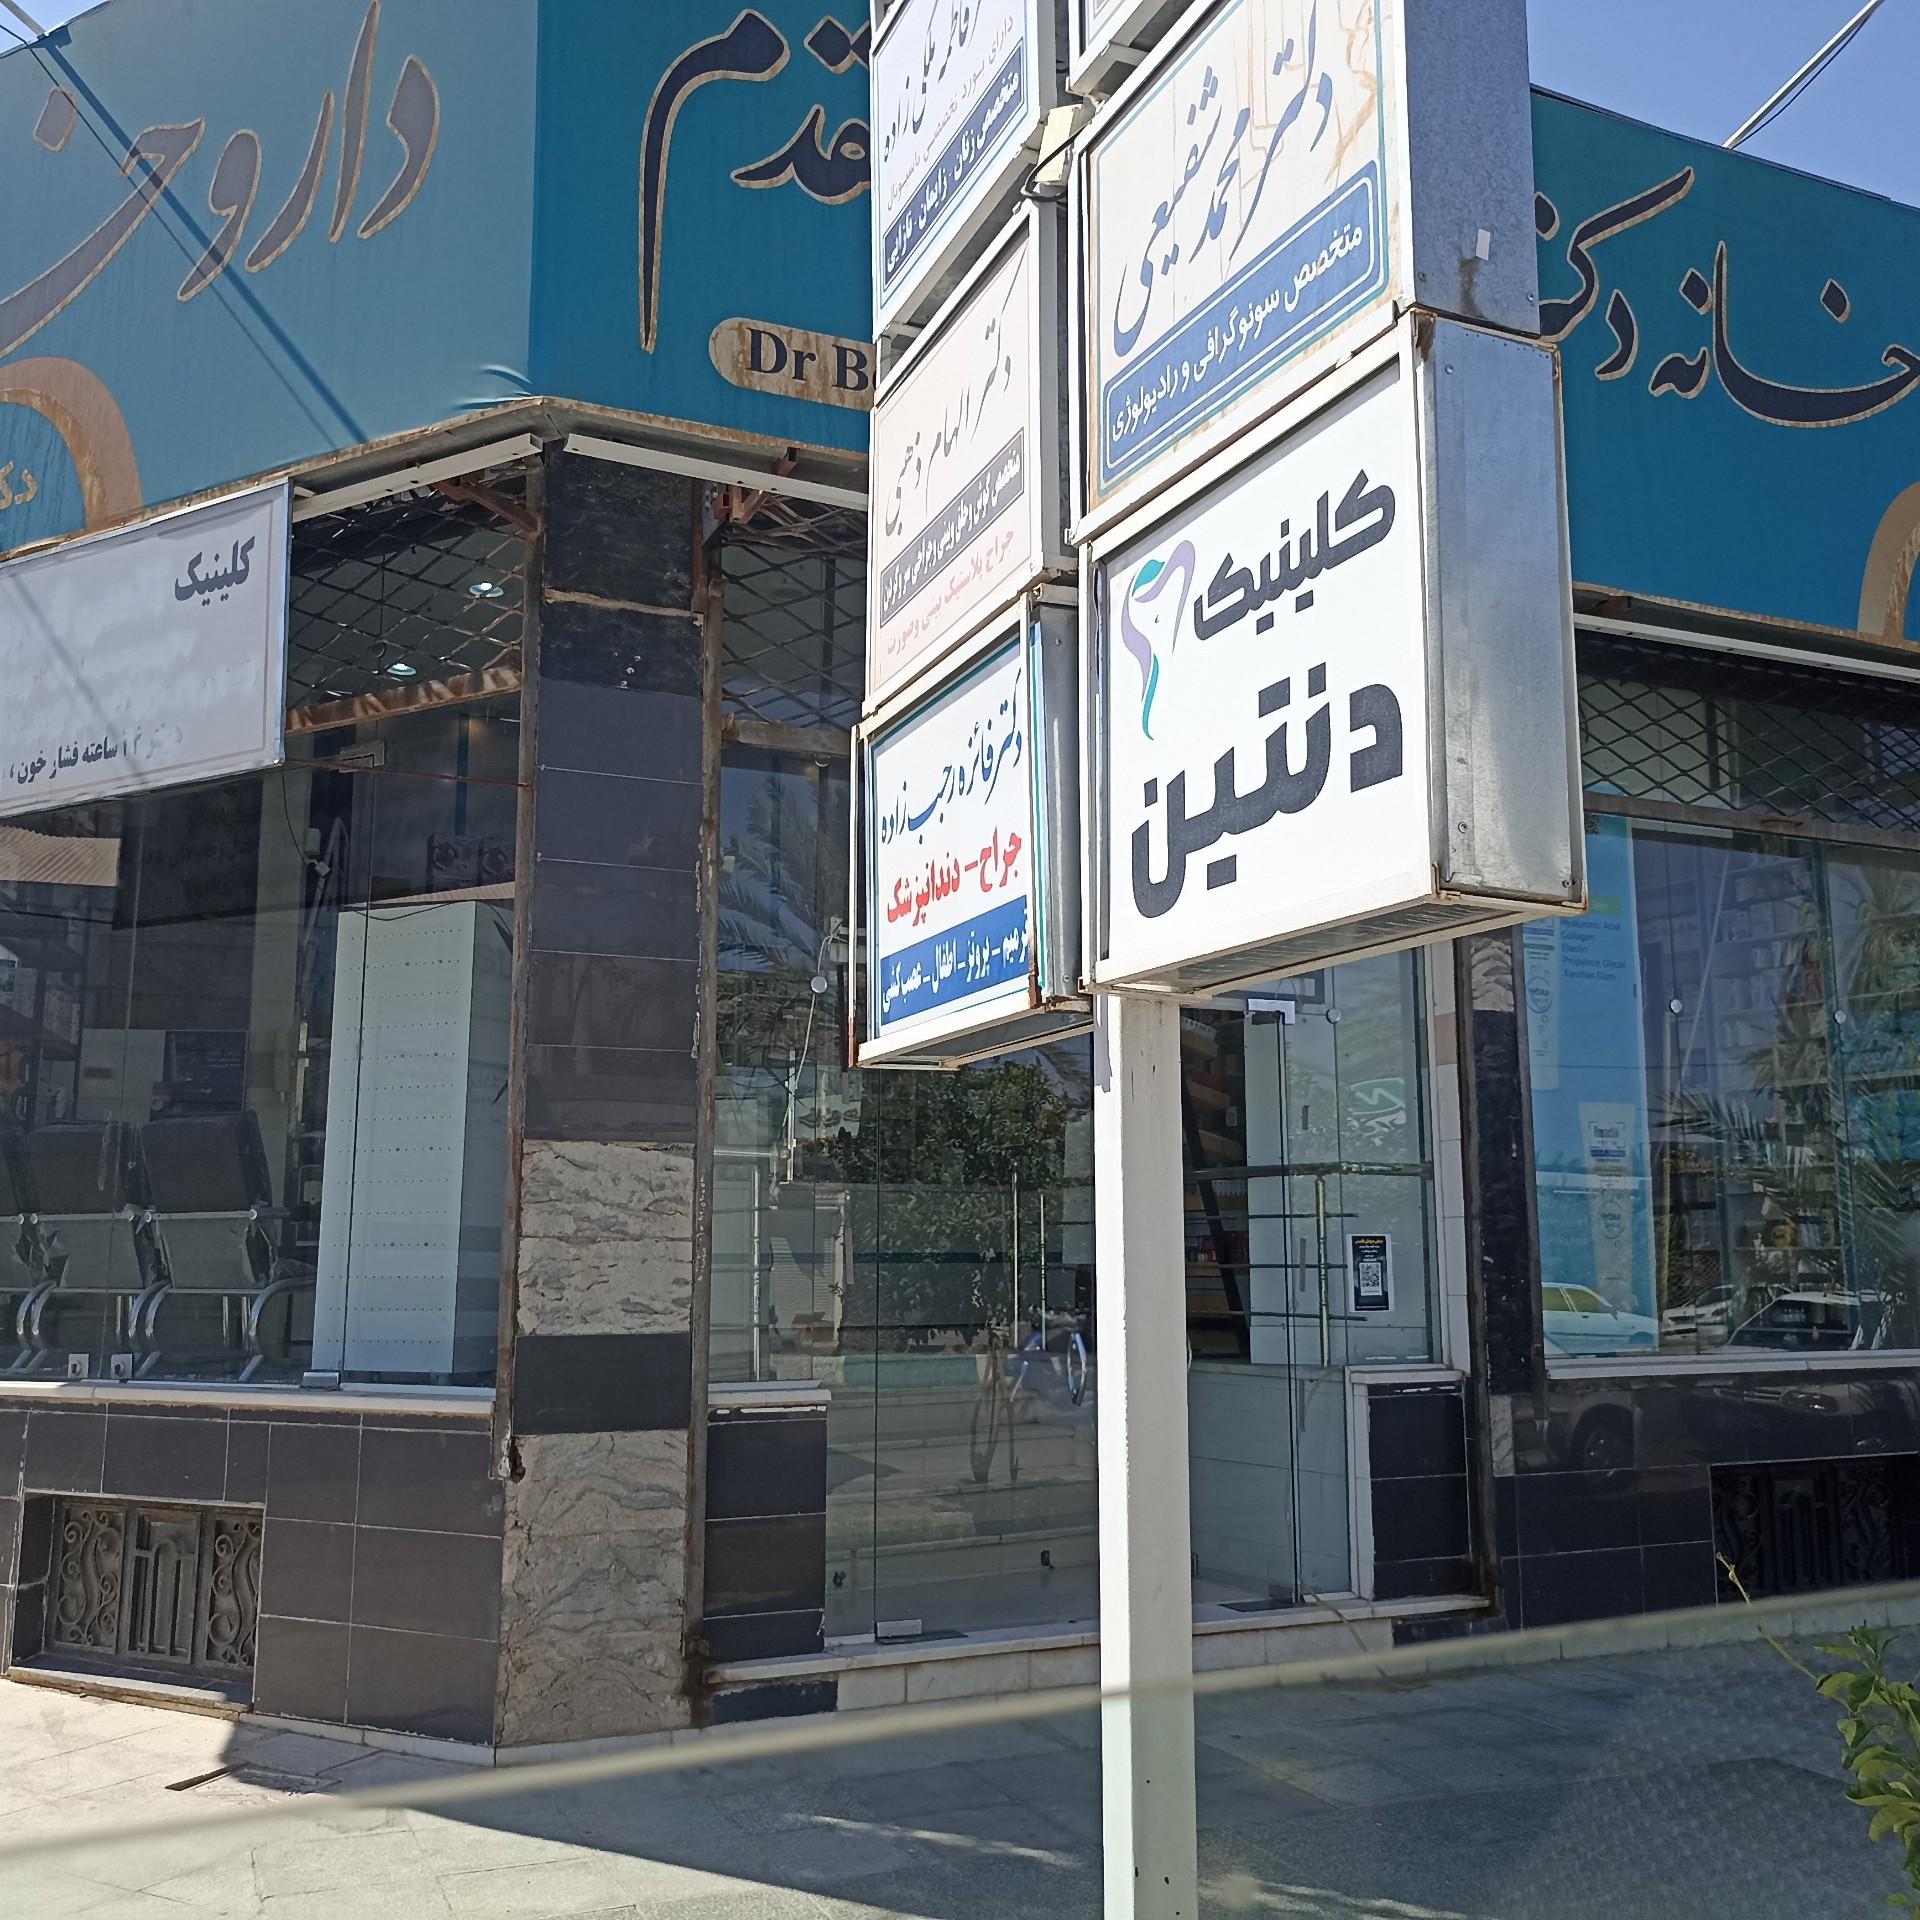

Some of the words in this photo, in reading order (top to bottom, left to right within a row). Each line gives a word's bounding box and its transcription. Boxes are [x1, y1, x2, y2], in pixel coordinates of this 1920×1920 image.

[976, 71, 1019, 150] متخصص
[953, 129, 975, 181] زنان
[1190, 107, 1251, 264] محمد
[918, 165, 948, 231] زایمان
[1113, 66, 1222, 357] شفیعی
[886, 209, 913, 273] نازایی
[1284, 223, 1363, 313] متخصص
[745, 327, 817, 382] Dr
[831, 343, 876, 393] B
[971, 240, 1028, 443] دکتر
[1180, 360, 1190, 392] و
[1193, 302, 1280, 383] سونوگرافی
[1111, 364, 1180, 443] رادیولوژی
[924, 382, 970, 514] الهام
[991, 449, 1021, 508] متخصص
[973, 471, 991, 525] گوش
[174, 536, 256, 607] کلینیک
[985, 531, 1014, 573] جراح
[1193, 469, 1396, 641] کلینیک
[49, 740, 79, 779] فشار
[82, 735, 118, 763] ساعته
[957, 718, 993, 797] فائزه
[984, 668, 1022, 804] دکتر
[1131, 661, 1403, 919] دنتین
[887, 851, 961, 926] دندانپزشک
[980, 826, 1022, 891] جراح
[931, 937, 957, 993] اطفال
